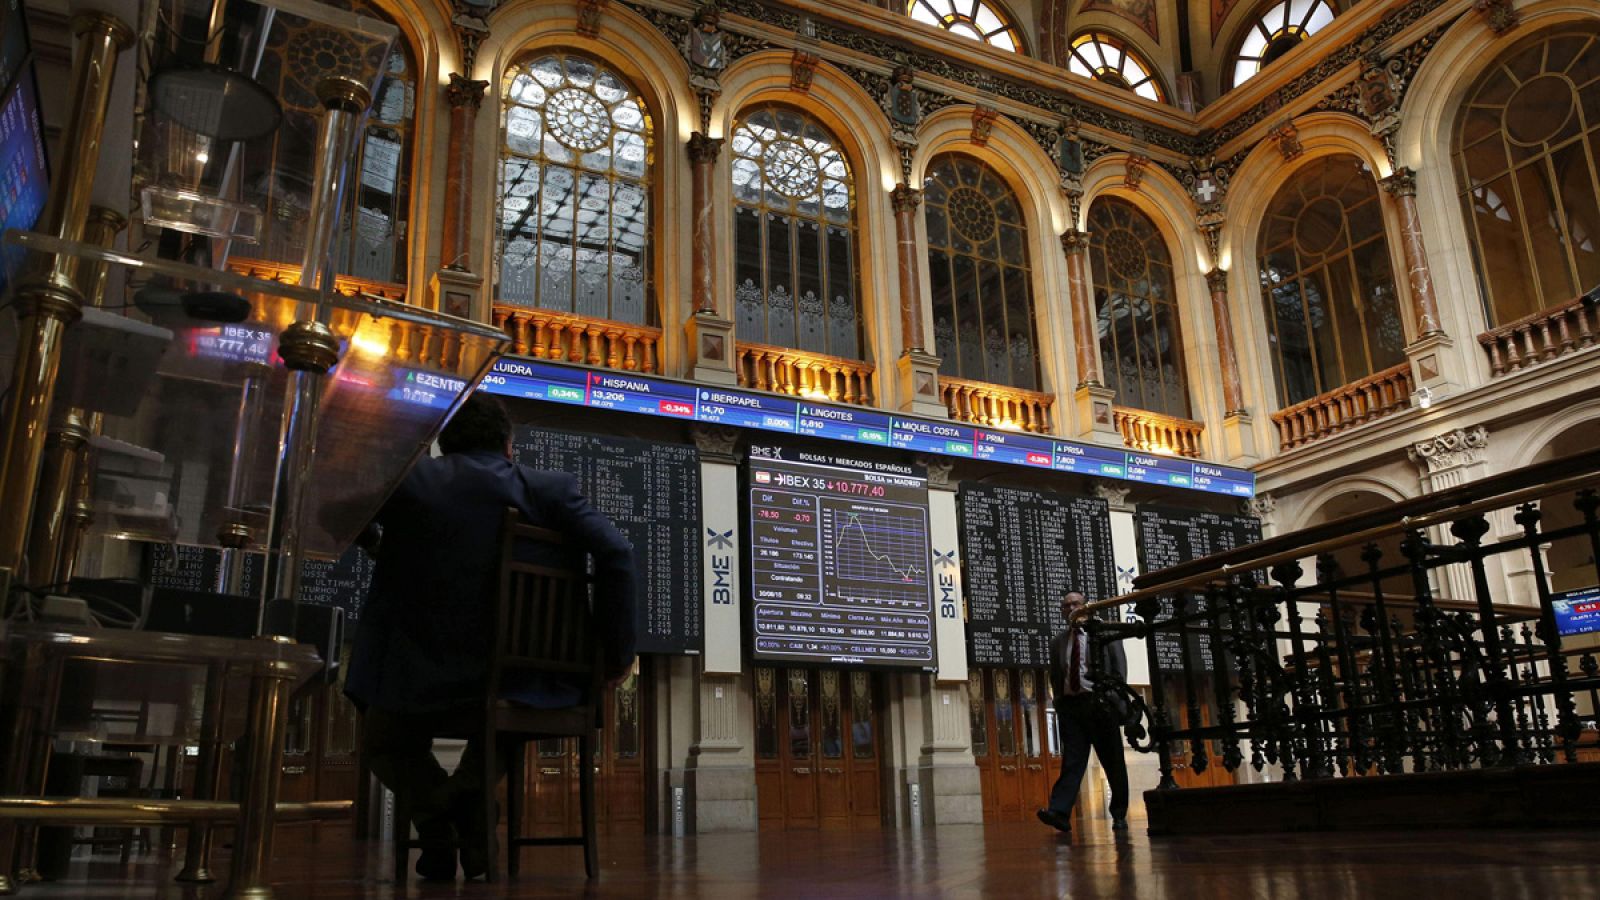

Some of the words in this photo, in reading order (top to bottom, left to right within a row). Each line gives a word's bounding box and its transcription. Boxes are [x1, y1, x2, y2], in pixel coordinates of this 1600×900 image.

[603, 378, 650, 392] HISPANIA
[711, 393, 762, 408] IBERPAPEL
[701, 405, 725, 415] 14,70
[810, 408, 853, 421] LINGOTES
[902, 422, 931, 433] MIQUEL
[933, 426, 960, 437] COSTA
[530, 431, 587, 443] COTIZACIONES
[986, 434, 1005, 443] PRIM
[1063, 445, 1084, 456] PRISA
[596, 458, 633, 468] MEDIASET
[752, 445, 771, 456] BME
[800, 452, 826, 463] BOLSAS
[835, 458, 872, 469] MERCADOS
[875, 463, 912, 474] ESPAÑOLES
[1135, 457, 1158, 467] QUABIT
[1200, 467, 1223, 477] REALIA
[783, 474, 810, 488] IBEX
[812, 478, 825, 489] 35
[864, 474, 885, 483] BOLSA
[894, 478, 921, 488] MADRID
[712, 555, 730, 604] BME
[939, 573, 955, 618] BME
[759, 608, 784, 616] Apertura
